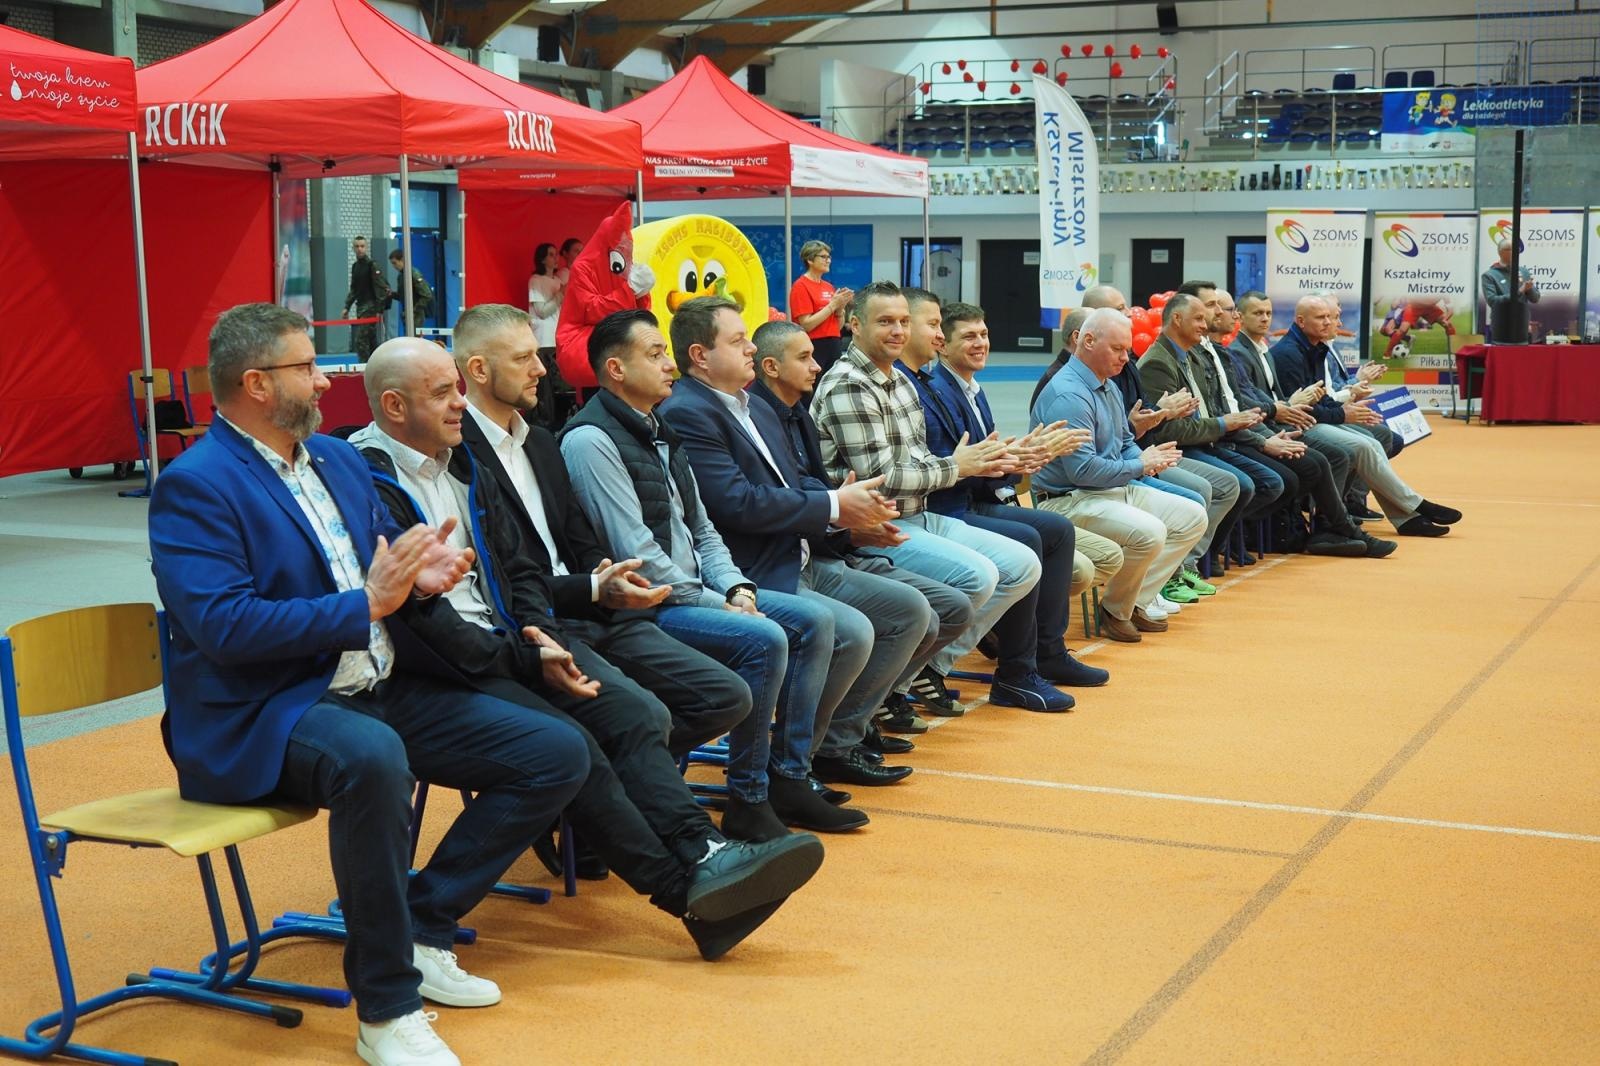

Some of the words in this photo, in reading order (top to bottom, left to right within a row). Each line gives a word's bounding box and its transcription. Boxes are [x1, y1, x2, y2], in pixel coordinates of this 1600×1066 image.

[10, 61, 61, 89] twoja
[66, 66, 111, 88] krew
[23, 88, 73, 109] moje
[1463, 98, 1543, 111] Lekkoatletyka
[1462, 112, 1474, 120] dla
[145, 102, 228, 146] RCKiK
[746, 156, 768, 166] ŻYCIE
[1312, 229, 1358, 241] ZSOMS
[1422, 233, 1469, 245] ZSOMS
[1528, 229, 1576, 241] ZSOMS
[1276, 264, 1340, 278] Kształcimy
[1384, 268, 1451, 281] Kształcimy
[1299, 279, 1354, 290] Mistrzów
[1407, 283, 1465, 294] Mistrzów
[1535, 280, 1572, 290] trzów
